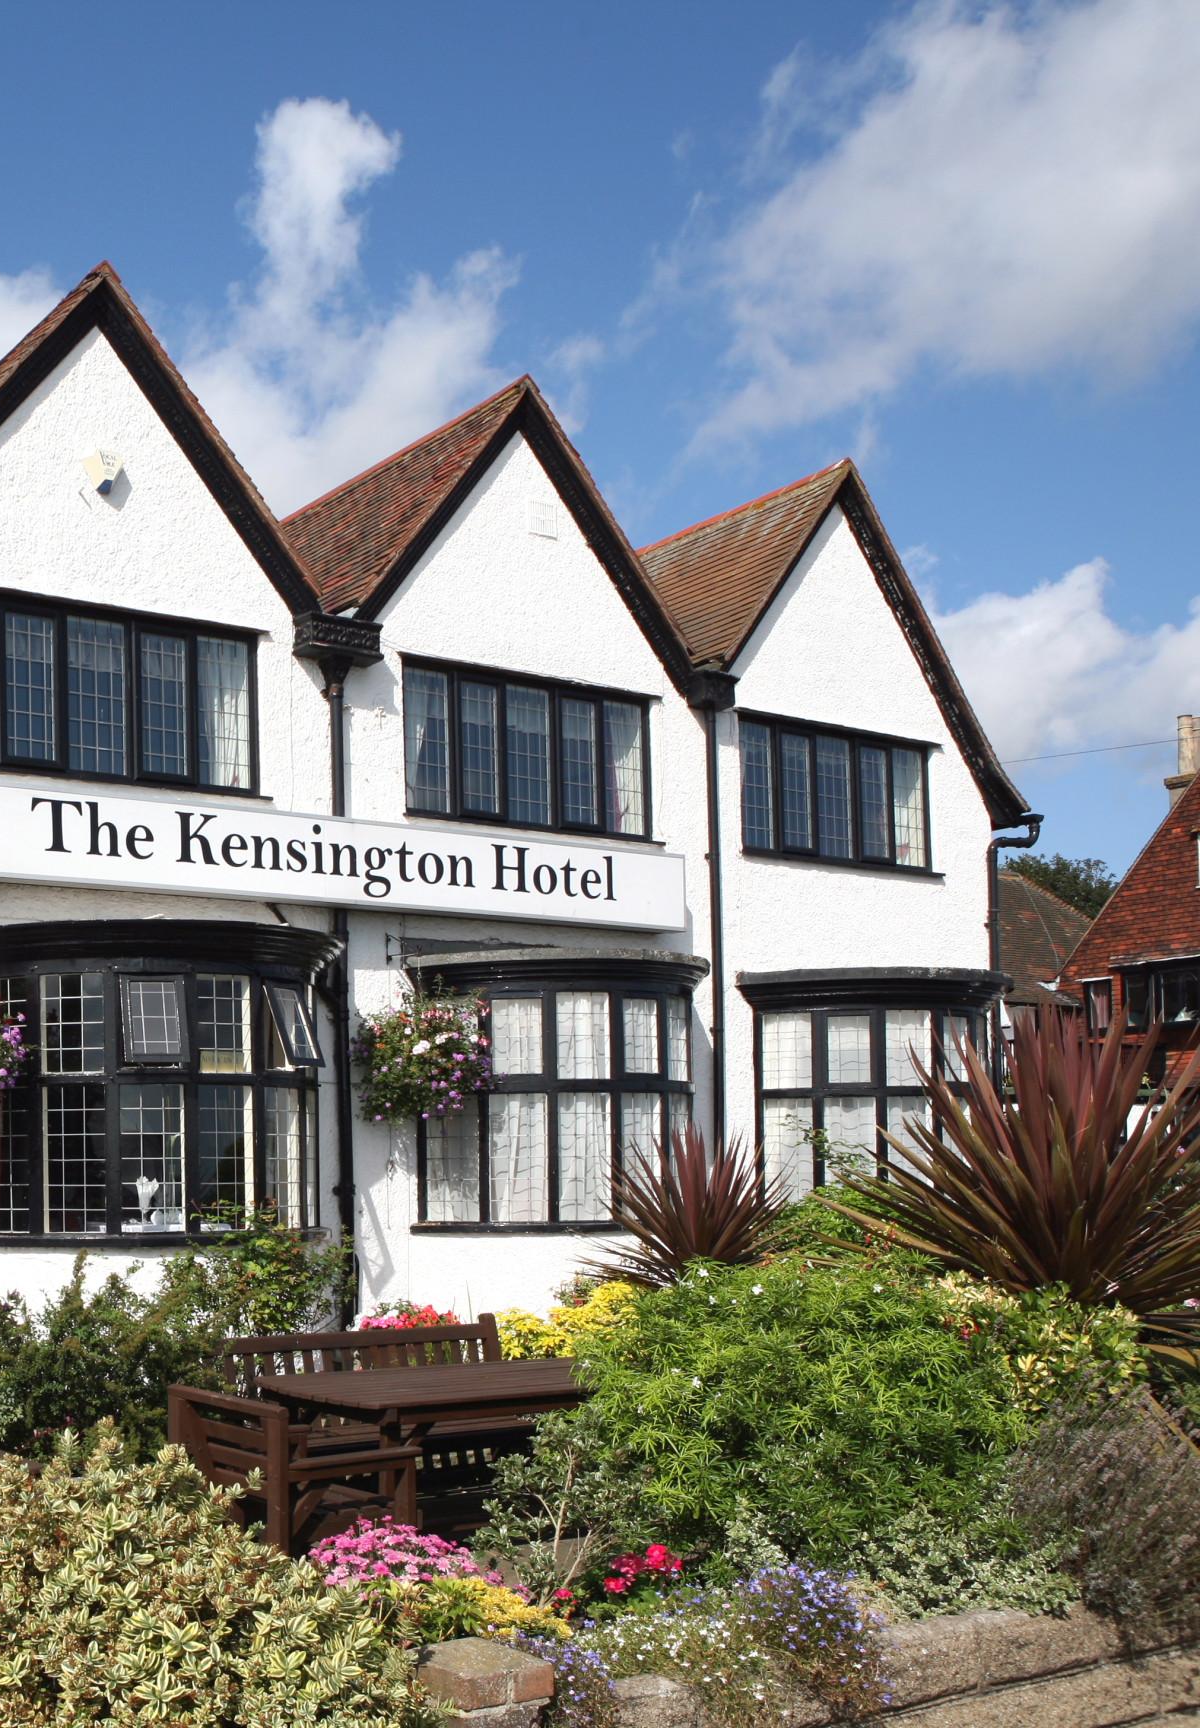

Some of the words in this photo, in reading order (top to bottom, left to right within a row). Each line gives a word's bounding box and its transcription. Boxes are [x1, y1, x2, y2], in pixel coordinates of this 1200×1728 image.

[31, 797, 155, 860] The
[174, 811, 476, 898] Kensington
[491, 843, 618, 901] Hotel
